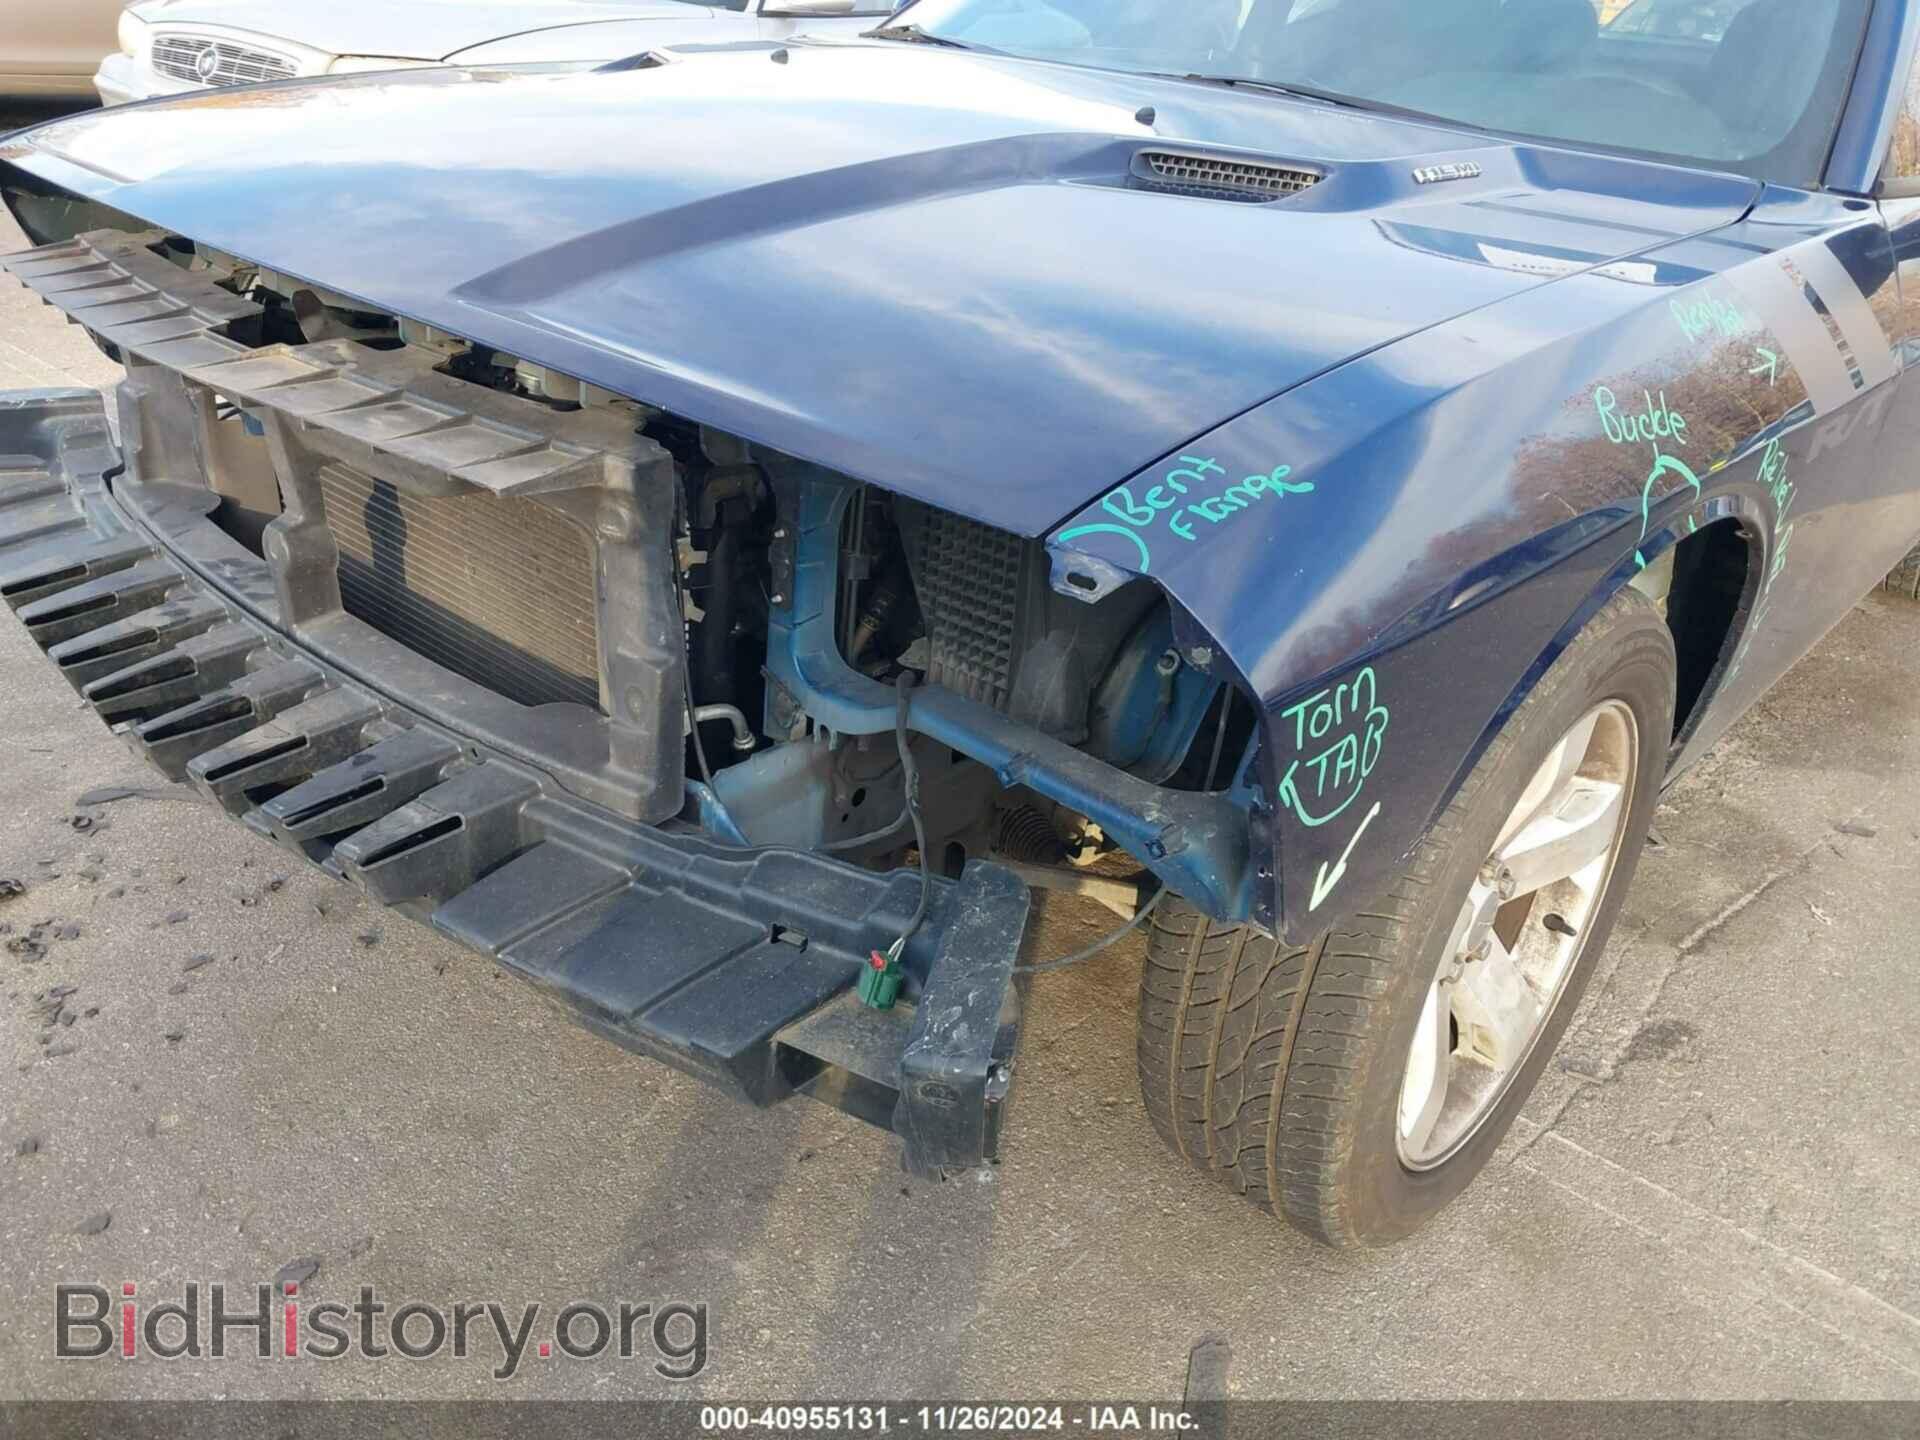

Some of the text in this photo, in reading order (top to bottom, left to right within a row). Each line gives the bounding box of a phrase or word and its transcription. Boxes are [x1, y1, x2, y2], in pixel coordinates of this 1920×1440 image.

[1593, 386, 1687, 445] Buckle
[1101, 454, 1226, 526] Bent
[1168, 464, 1316, 541] Flange
[1280, 666, 1377, 751] Torn
[1305, 706, 1390, 798] TAB
